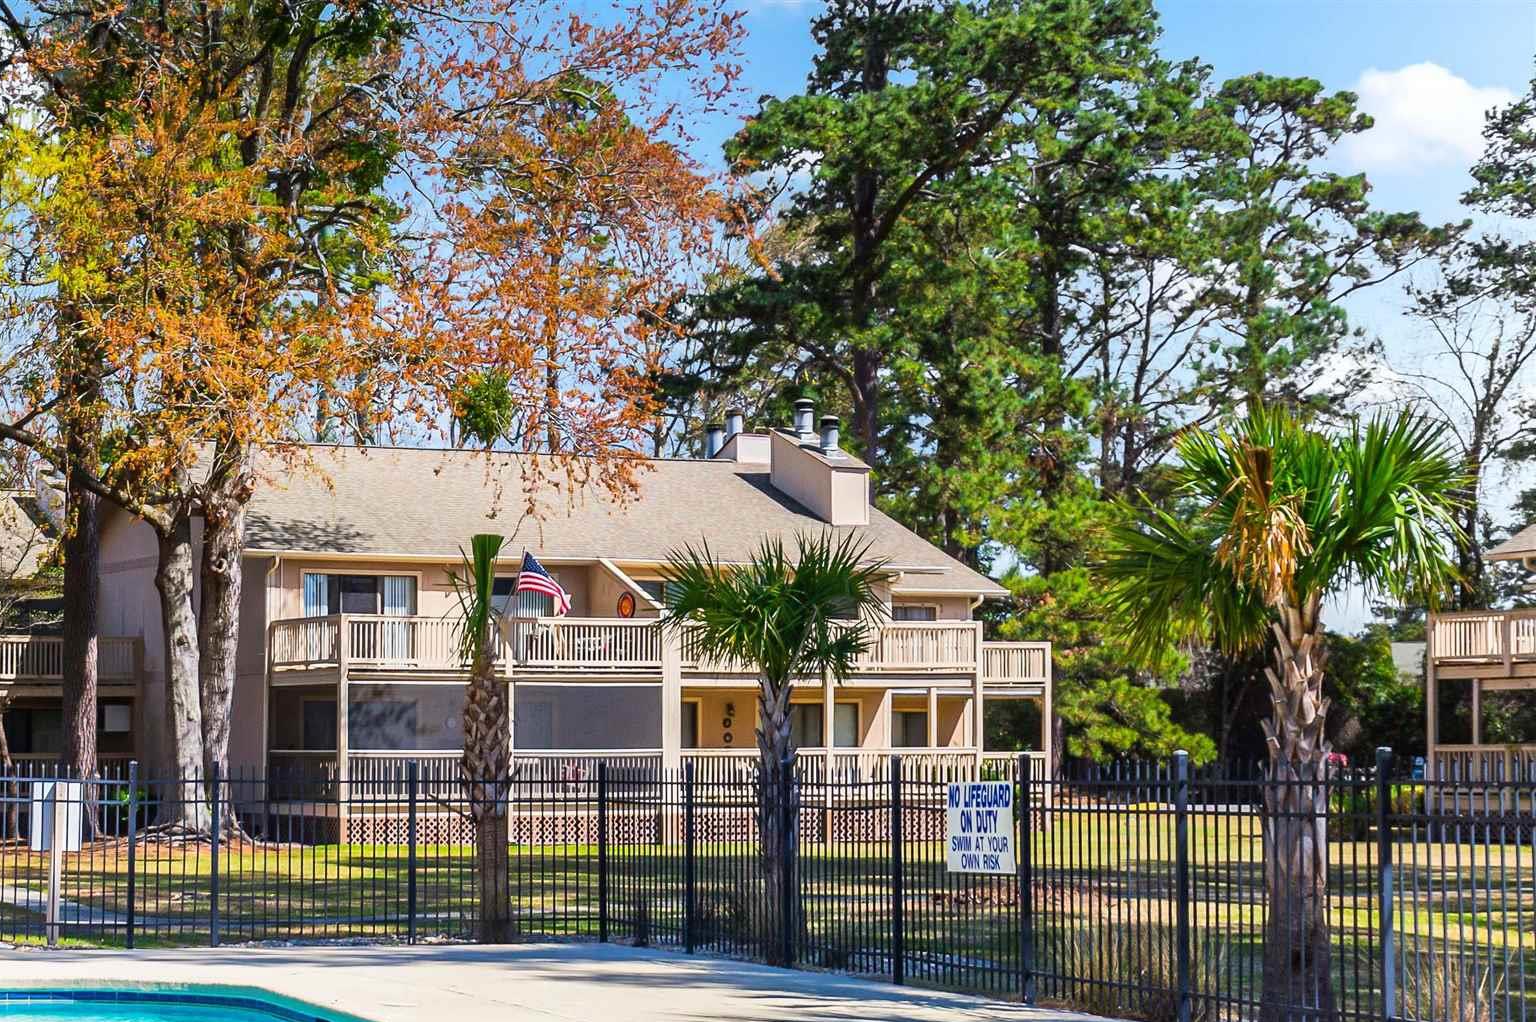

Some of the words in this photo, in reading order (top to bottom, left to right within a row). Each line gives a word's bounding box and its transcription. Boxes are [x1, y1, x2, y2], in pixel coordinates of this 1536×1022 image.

[948, 784, 961, 808] NO
[964, 784, 1011, 808] LIFEGUARD
[960, 810, 972, 833] ON
[976, 810, 998, 833] DUTY
[951, 836, 972, 852] SWIM
[975, 836, 985, 852] AT
[988, 836, 1009, 853] YOUR
[961, 853, 980, 869] OWN
[983, 854, 1001, 870] RISK
